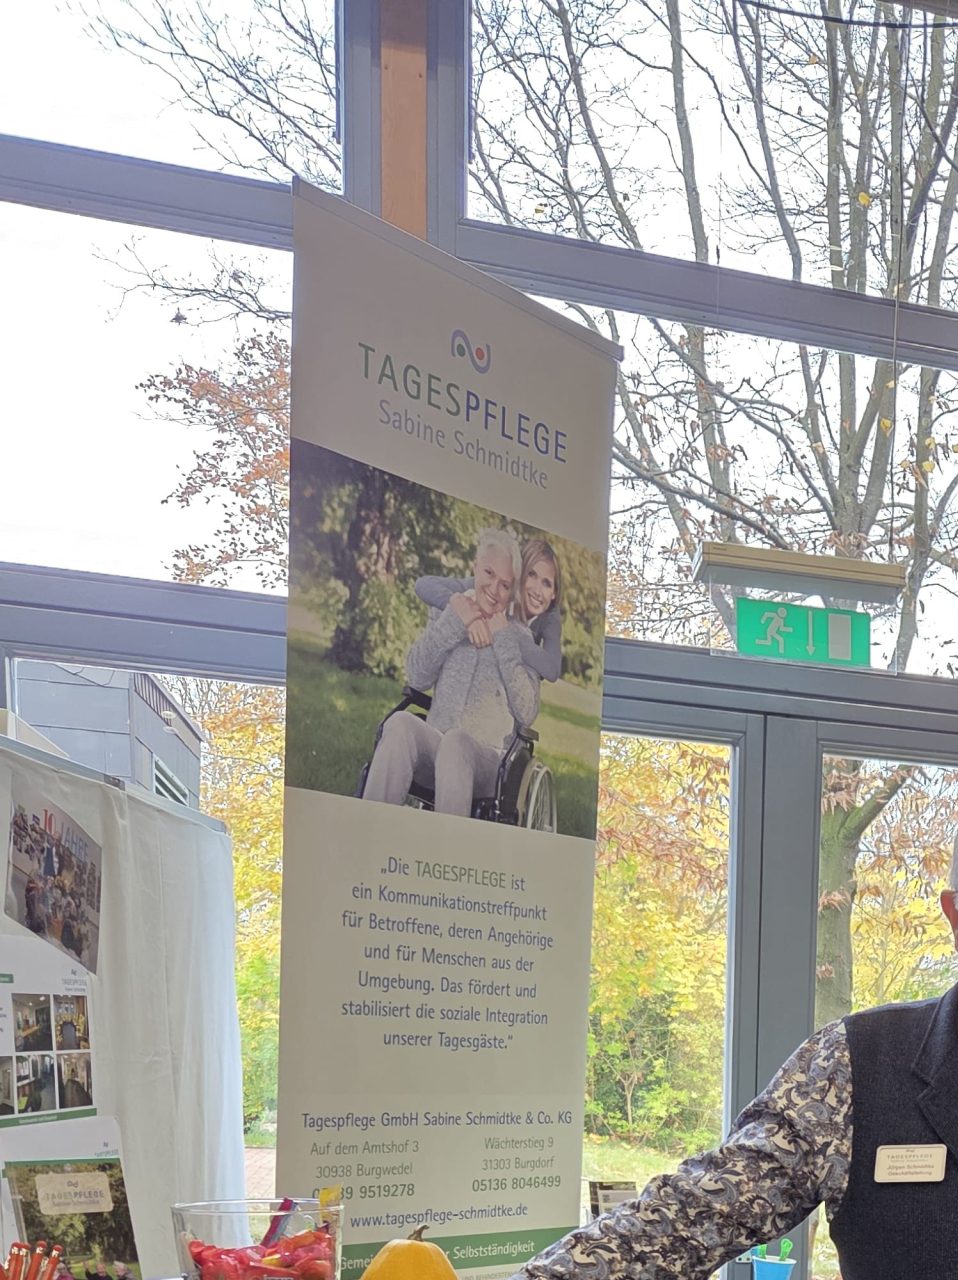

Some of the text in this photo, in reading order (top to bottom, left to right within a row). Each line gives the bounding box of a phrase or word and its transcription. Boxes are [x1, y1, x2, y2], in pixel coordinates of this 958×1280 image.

[358, 342, 567, 463] TAGESPFLEGE
[379, 399, 549, 490] Sabine Schmidtke
[415, 860, 507, 888] TAGESPFLEGE
[511, 874, 526, 891] ist
[352, 882, 548, 921] ein Kommunikationstreffpunkt
[342, 910, 554, 950] für Betroffene, deren Angehörige
[364, 944, 534, 972] und für Menschen aus der
[358, 970, 537, 999] Umgebung. Das fördert und
[341, 1000, 548, 1027] stabilisiert die soziale Integration
[383, 1032, 433, 1046] unserer
[301, 1110, 573, 1132] Tagespflege GmbH Sabine Schmidtke & Co. KG
[310, 1140, 420, 1156] Auf dem Amtshof 3
[484, 1136, 554, 1151] Wächterstieg 9
[316, 1162, 413, 1180] 30938 Burgwedel
[482, 1155, 556, 1172] 31303 Burgdorf
[359, 1183, 415, 1199] 9519278
[472, 1175, 562, 1192] 05136 8046499
[350, 1203, 529, 1228] www.tagespflege-schmidtke.de
[453, 1240, 535, 1260] Selbstständigkeit
